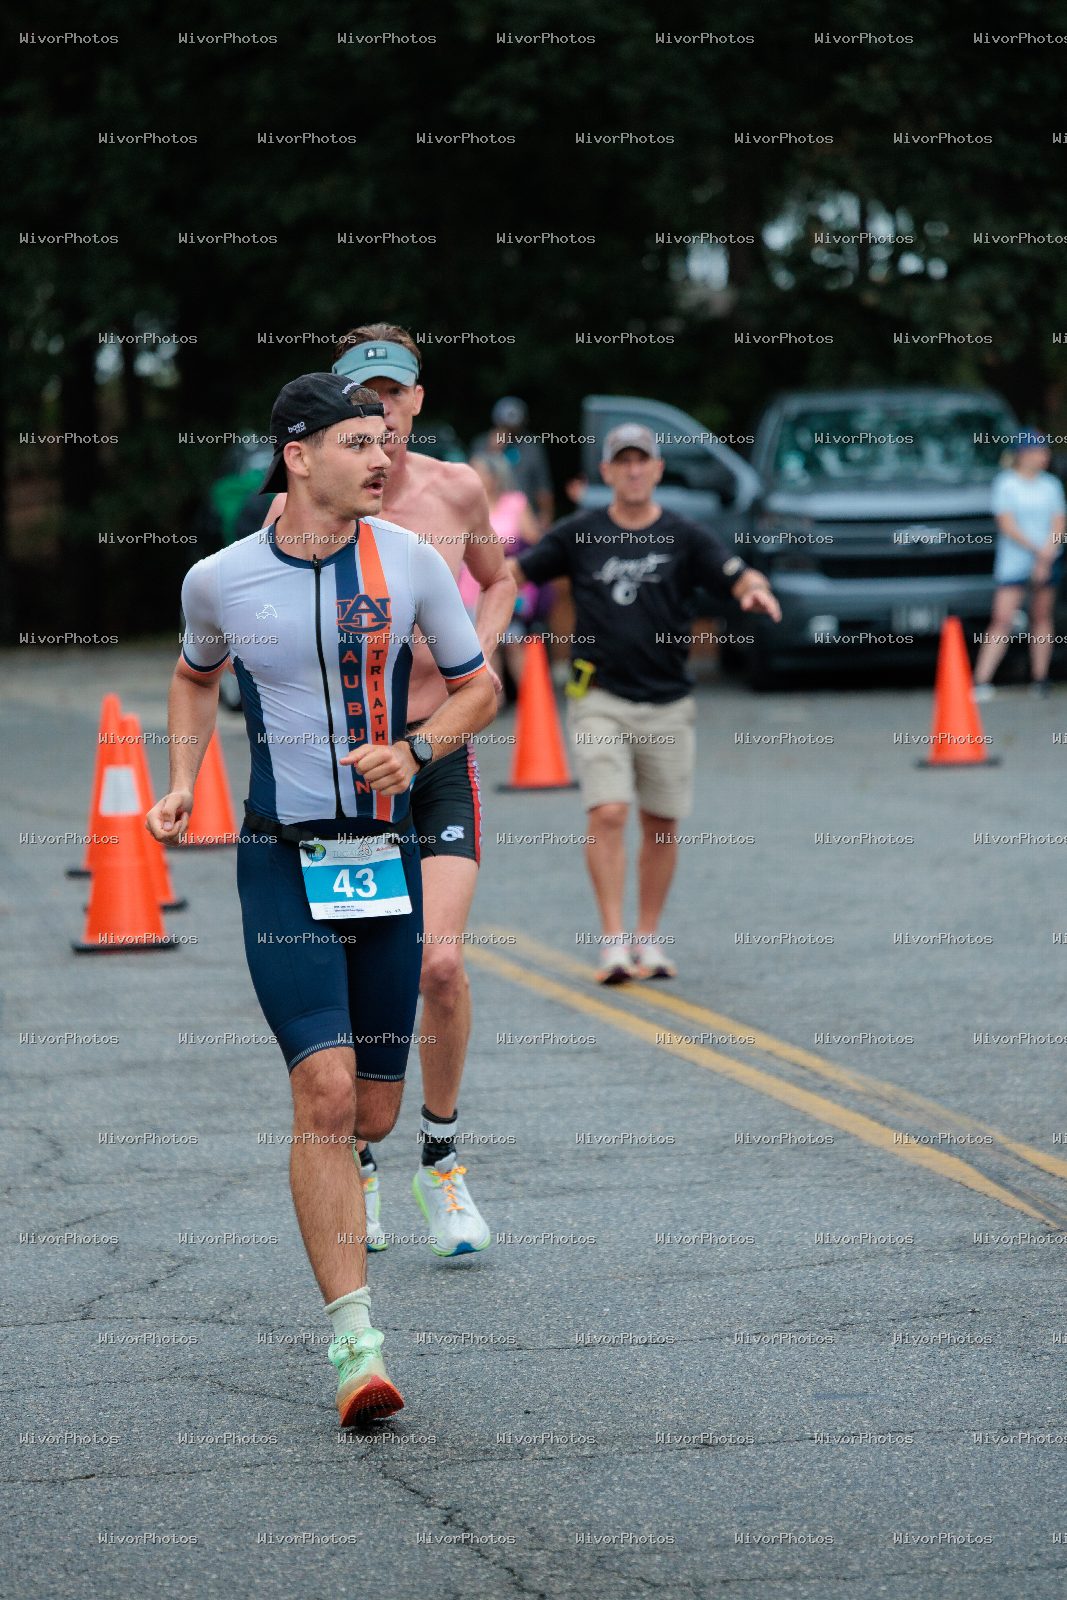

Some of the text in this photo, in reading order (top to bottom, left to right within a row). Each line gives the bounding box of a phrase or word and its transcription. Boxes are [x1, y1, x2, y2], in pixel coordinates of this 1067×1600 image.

[342, 650, 371, 795] AUBUN
[370, 649, 386, 741] TRIATH
[333, 867, 378, 898] 43
